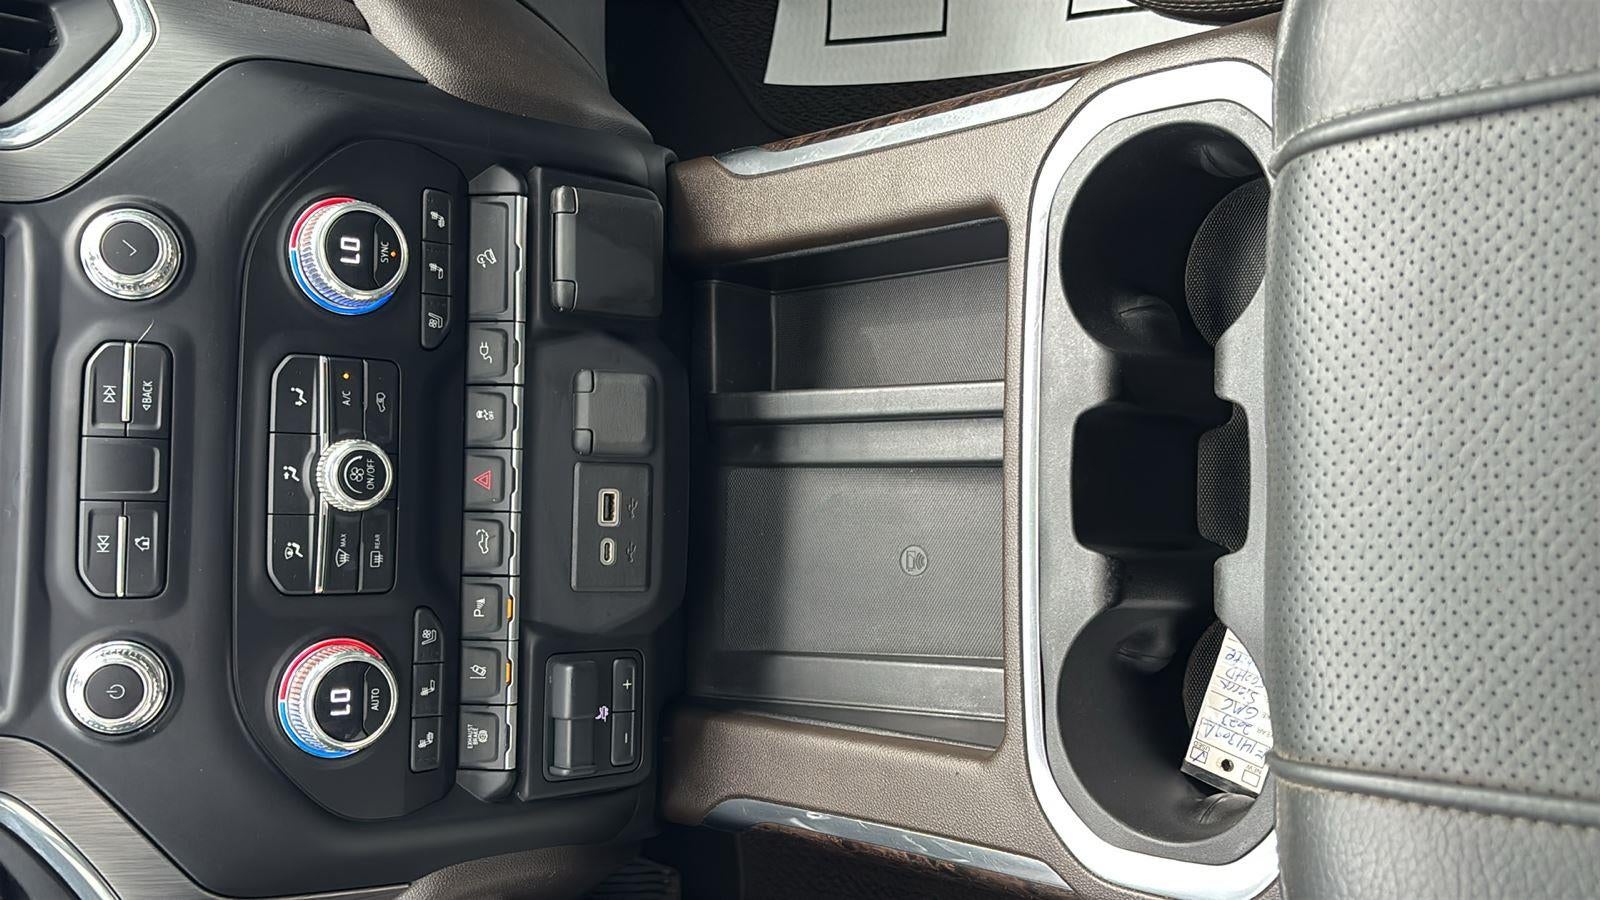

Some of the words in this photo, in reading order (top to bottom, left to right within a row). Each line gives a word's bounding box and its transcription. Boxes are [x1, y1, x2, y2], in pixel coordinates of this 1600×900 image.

[379, 240, 390, 264] SYNC
[142, 380, 154, 403] BACK
[342, 389, 352, 406] A/C
[365, 458, 376, 490] ON/OFF
[339, 533, 348, 547] MAX
[373, 533, 381, 549] REAR
[370, 687, 381, 712] AUTO
[1221, 698, 1259, 720] GMC
[1222, 714, 1253, 735] 2023
[1193, 741, 1211, 751] USED
[1245, 764, 1262, 774] NEW
